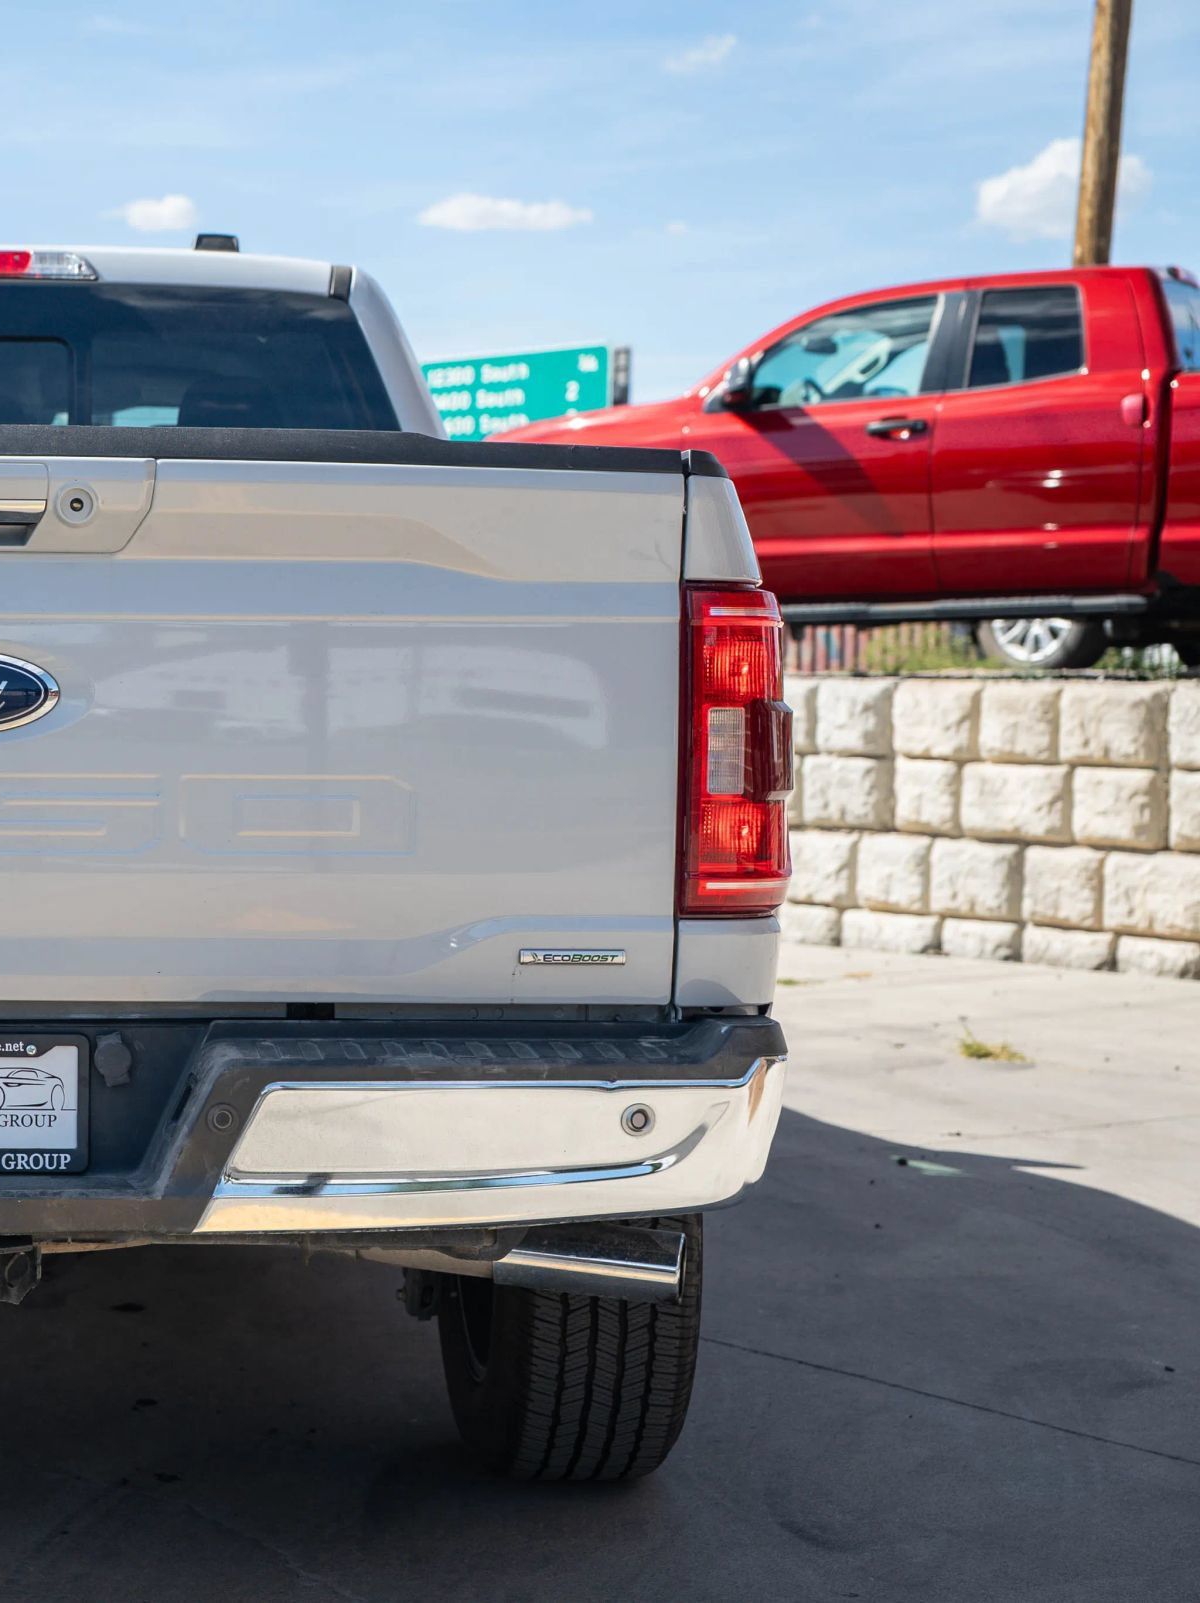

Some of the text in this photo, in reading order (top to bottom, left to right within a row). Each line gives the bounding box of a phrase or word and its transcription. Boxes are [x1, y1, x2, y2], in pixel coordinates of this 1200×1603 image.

[480, 362, 530, 384] South
[475, 388, 525, 409] South
[1, 1153, 71, 1170] GROUP
